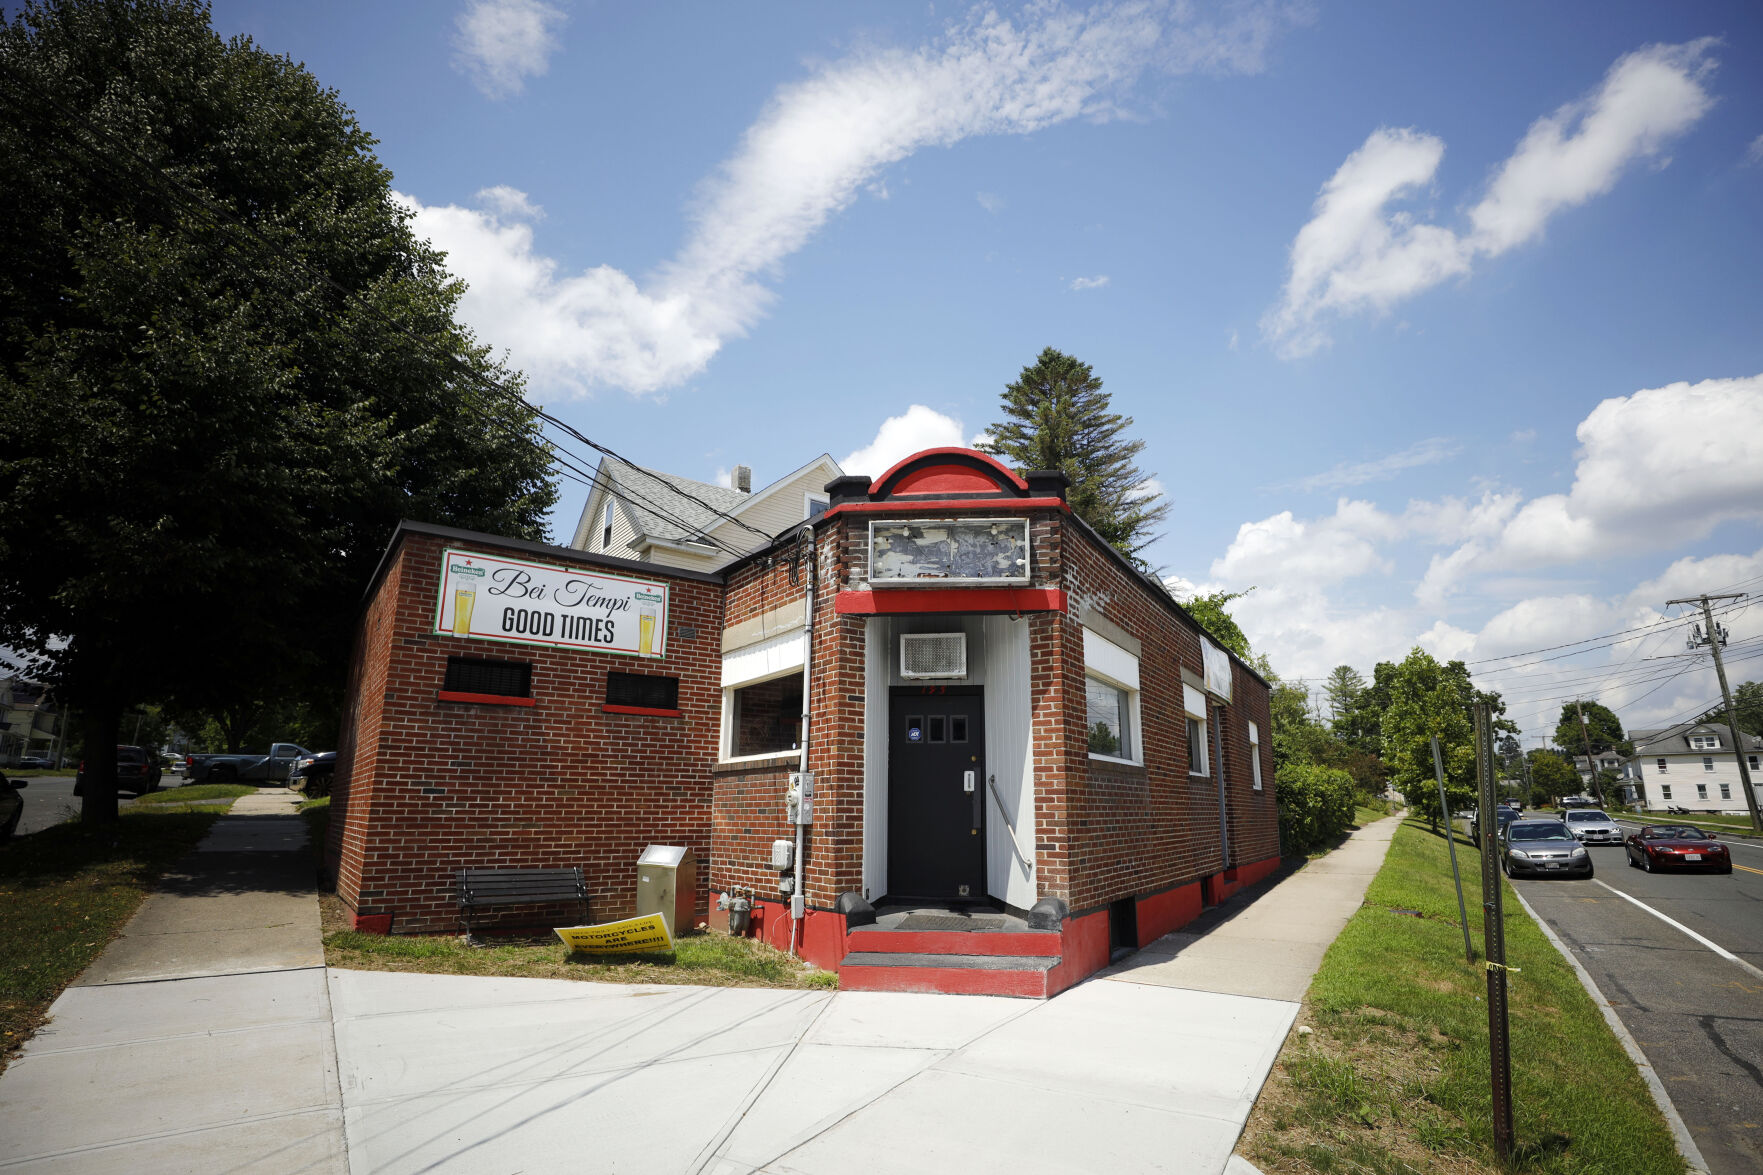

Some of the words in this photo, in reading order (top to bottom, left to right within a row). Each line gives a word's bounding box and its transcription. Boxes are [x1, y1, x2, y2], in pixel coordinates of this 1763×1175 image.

[452, 566, 484, 576] Heineken
[488, 568, 546, 601] Bei
[554, 580, 631, 618] Tempi
[502, 607, 555, 637] GOOD
[561, 614, 615, 643] TIMES
[571, 925, 656, 940] MOTORCYCLES
[605, 936, 628, 944] ARE
